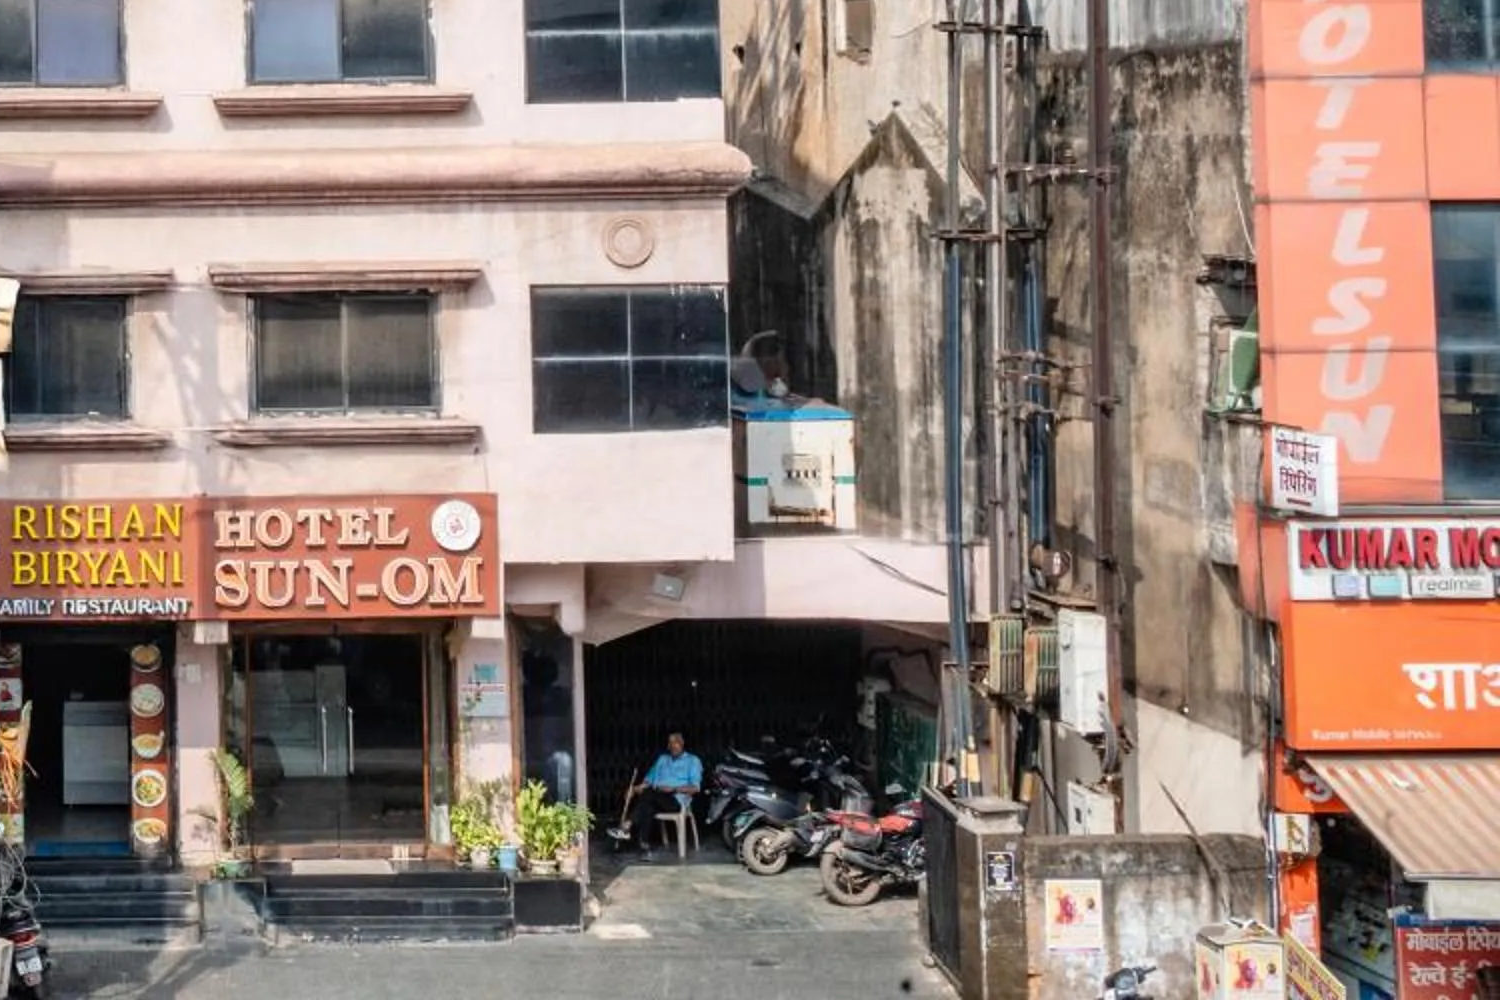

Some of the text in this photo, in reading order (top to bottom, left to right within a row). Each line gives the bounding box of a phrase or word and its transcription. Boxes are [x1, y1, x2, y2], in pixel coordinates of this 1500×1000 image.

[1310, 276, 1394, 464] SUN
[11, 502, 183, 541] RISHAN
[214, 506, 411, 549] HOTEL
[11, 550, 184, 587] BIRYANI
[1298, 527, 1440, 570] KUMAR
[214, 555, 484, 609] SUN-OM
[1417, 575, 1483, 592] realme
